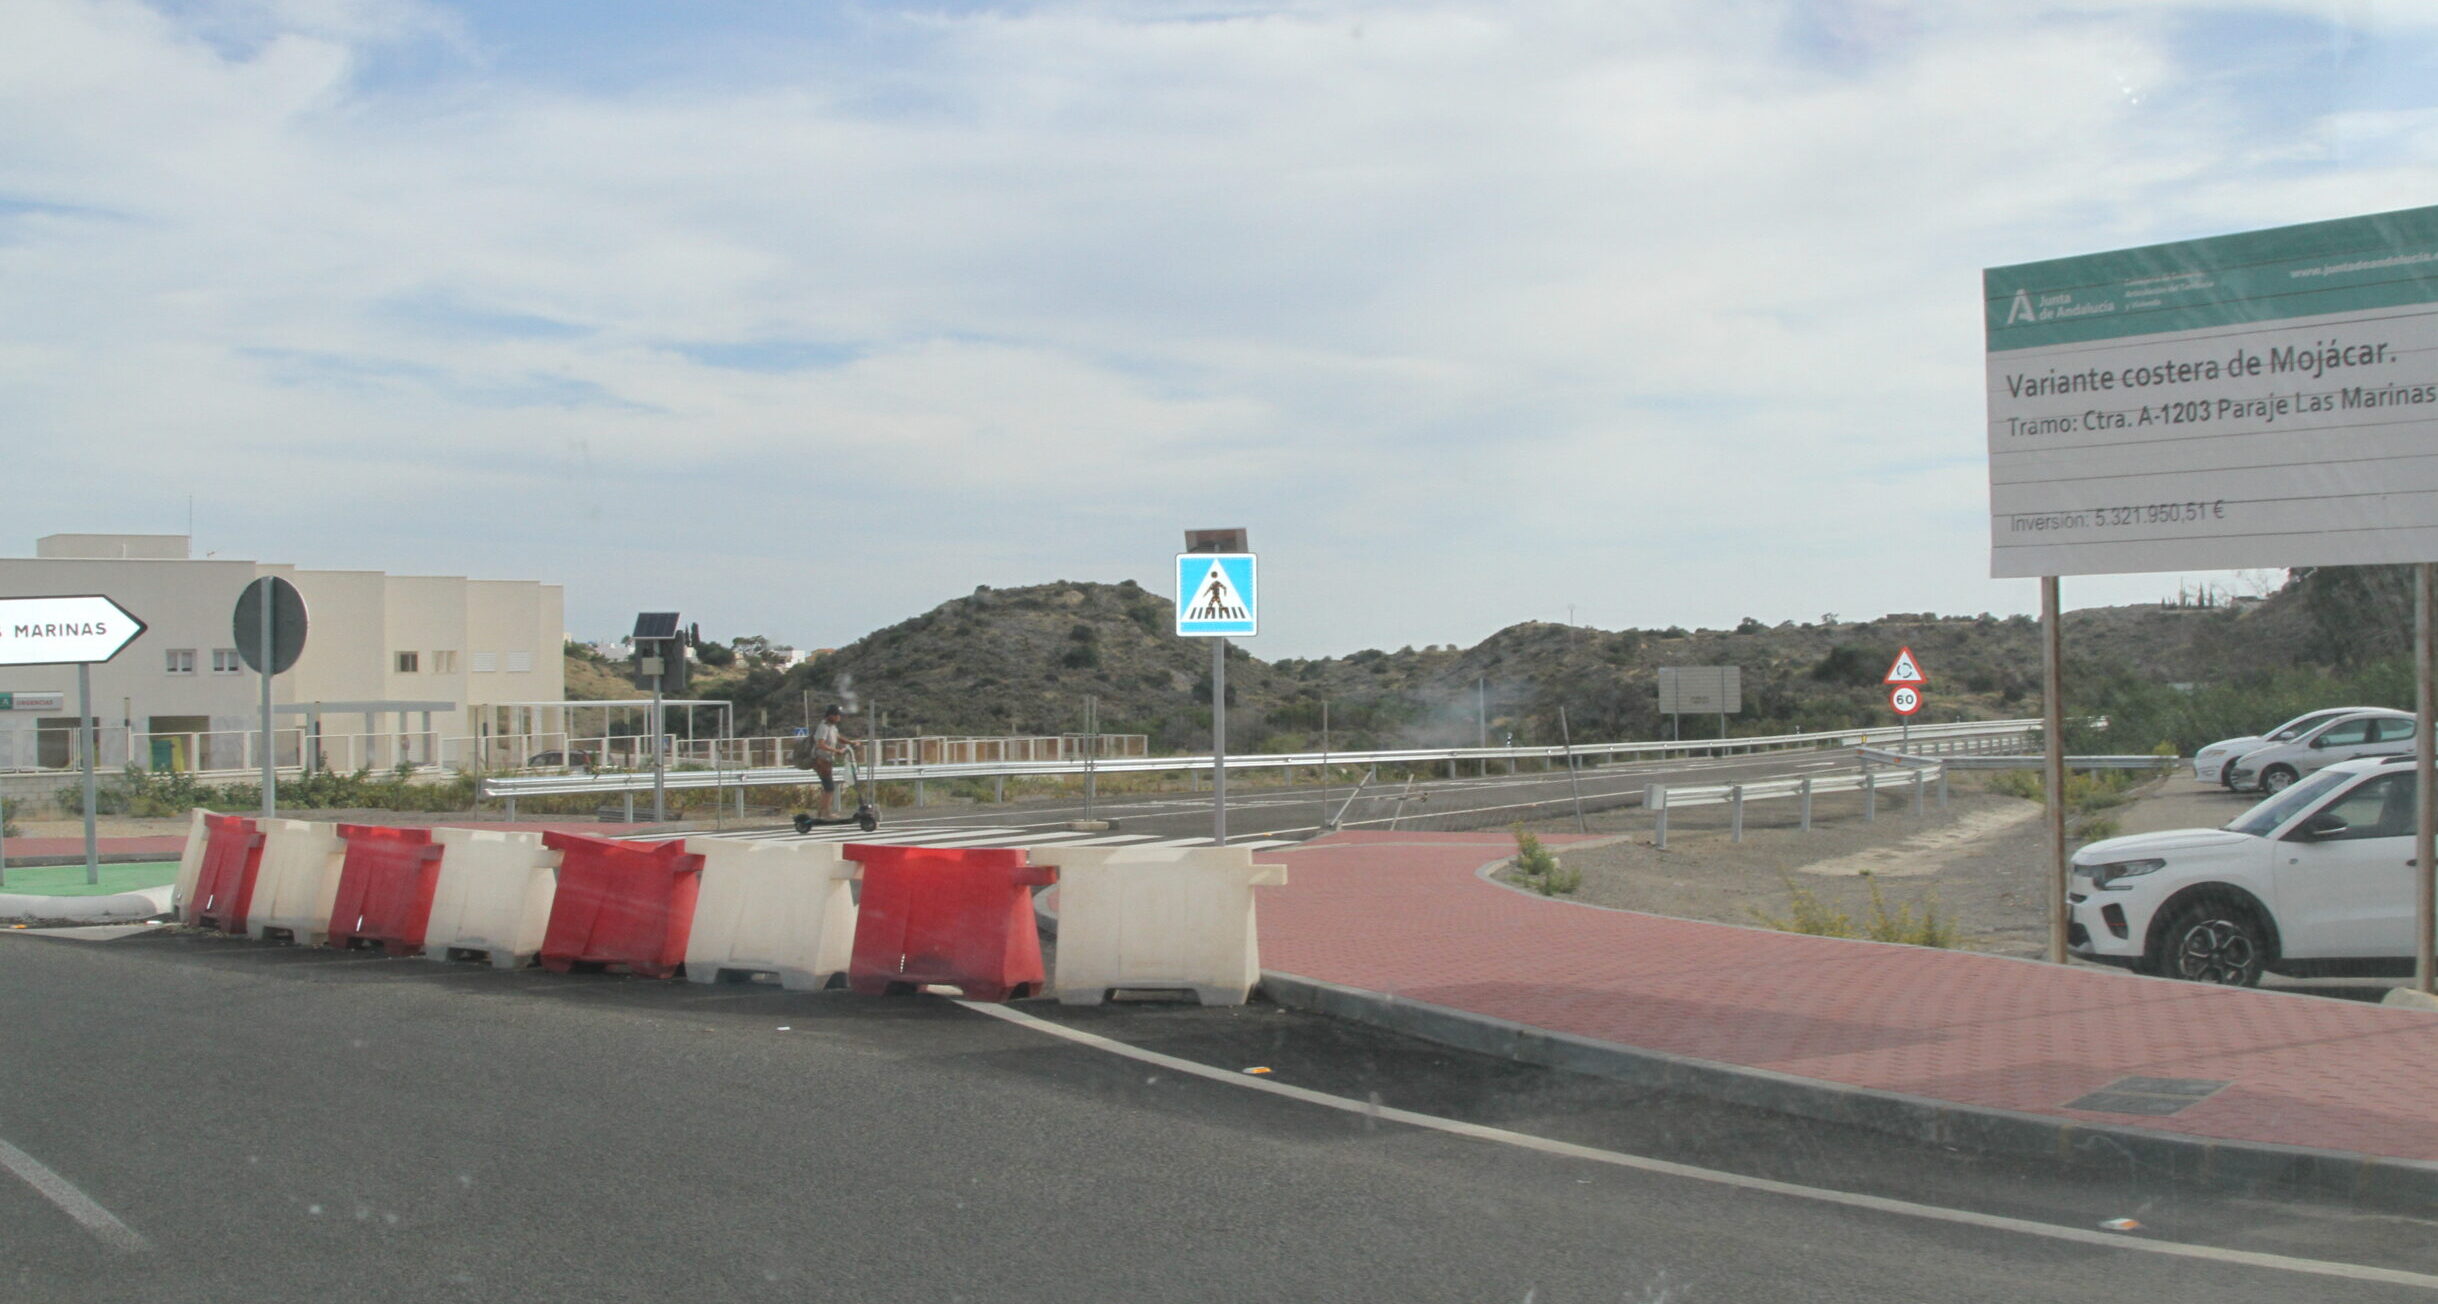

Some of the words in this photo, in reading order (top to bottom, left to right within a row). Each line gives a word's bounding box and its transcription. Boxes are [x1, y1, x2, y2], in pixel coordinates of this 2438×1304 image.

[2040, 294, 2072, 308] Junta
[2040, 308, 2055, 320] de
[2006, 367, 2114, 399] Variante
[2122, 360, 2219, 388] costera
[2228, 348, 2262, 378] de
[2270, 339, 2397, 379] Mojácar.
[2009, 417, 2078, 437] Tramo:
[2083, 410, 2133, 431] Ctra.
[2138, 399, 2211, 426] A-1203
[2218, 393, 2289, 423] Paraje
[2296, 391, 2334, 413] Las
[2341, 382, 2437, 410] Marinas
[2095, 501, 2206, 528] 5.321.950,51
[2213, 500, 2225, 519] €
[14, 622, 107, 638] MARINAS
[1896, 694, 1914, 705] 60
